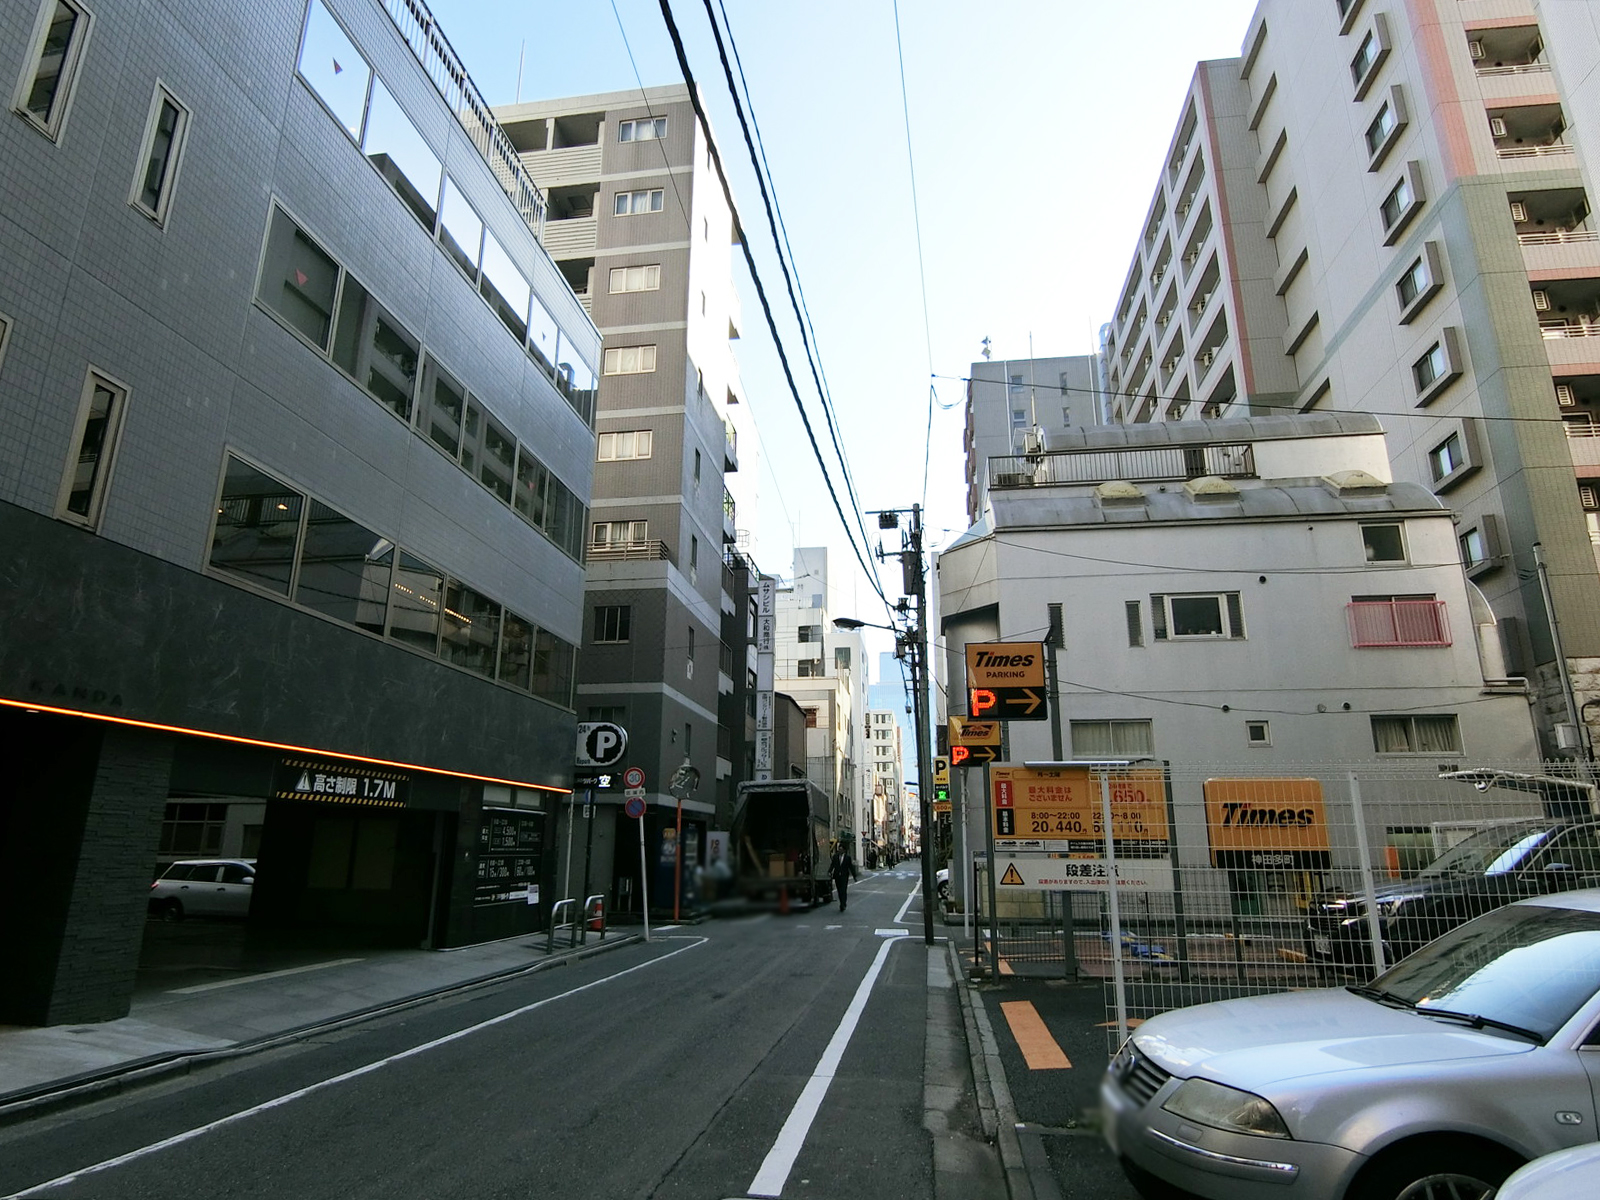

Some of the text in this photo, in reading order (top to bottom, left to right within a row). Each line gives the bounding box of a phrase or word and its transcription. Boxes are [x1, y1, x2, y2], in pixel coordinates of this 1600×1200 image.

[975, 652, 1034, 667] Times
[971, 690, 996, 716] P
[596, 731, 617, 758] P
[952, 746, 969, 765] P
[935, 760, 946, 775] P
[313, 774, 396, 799] 高さ制限 1.7M
[598, 775, 611, 787] 空
[1221, 803, 1314, 828] Times
